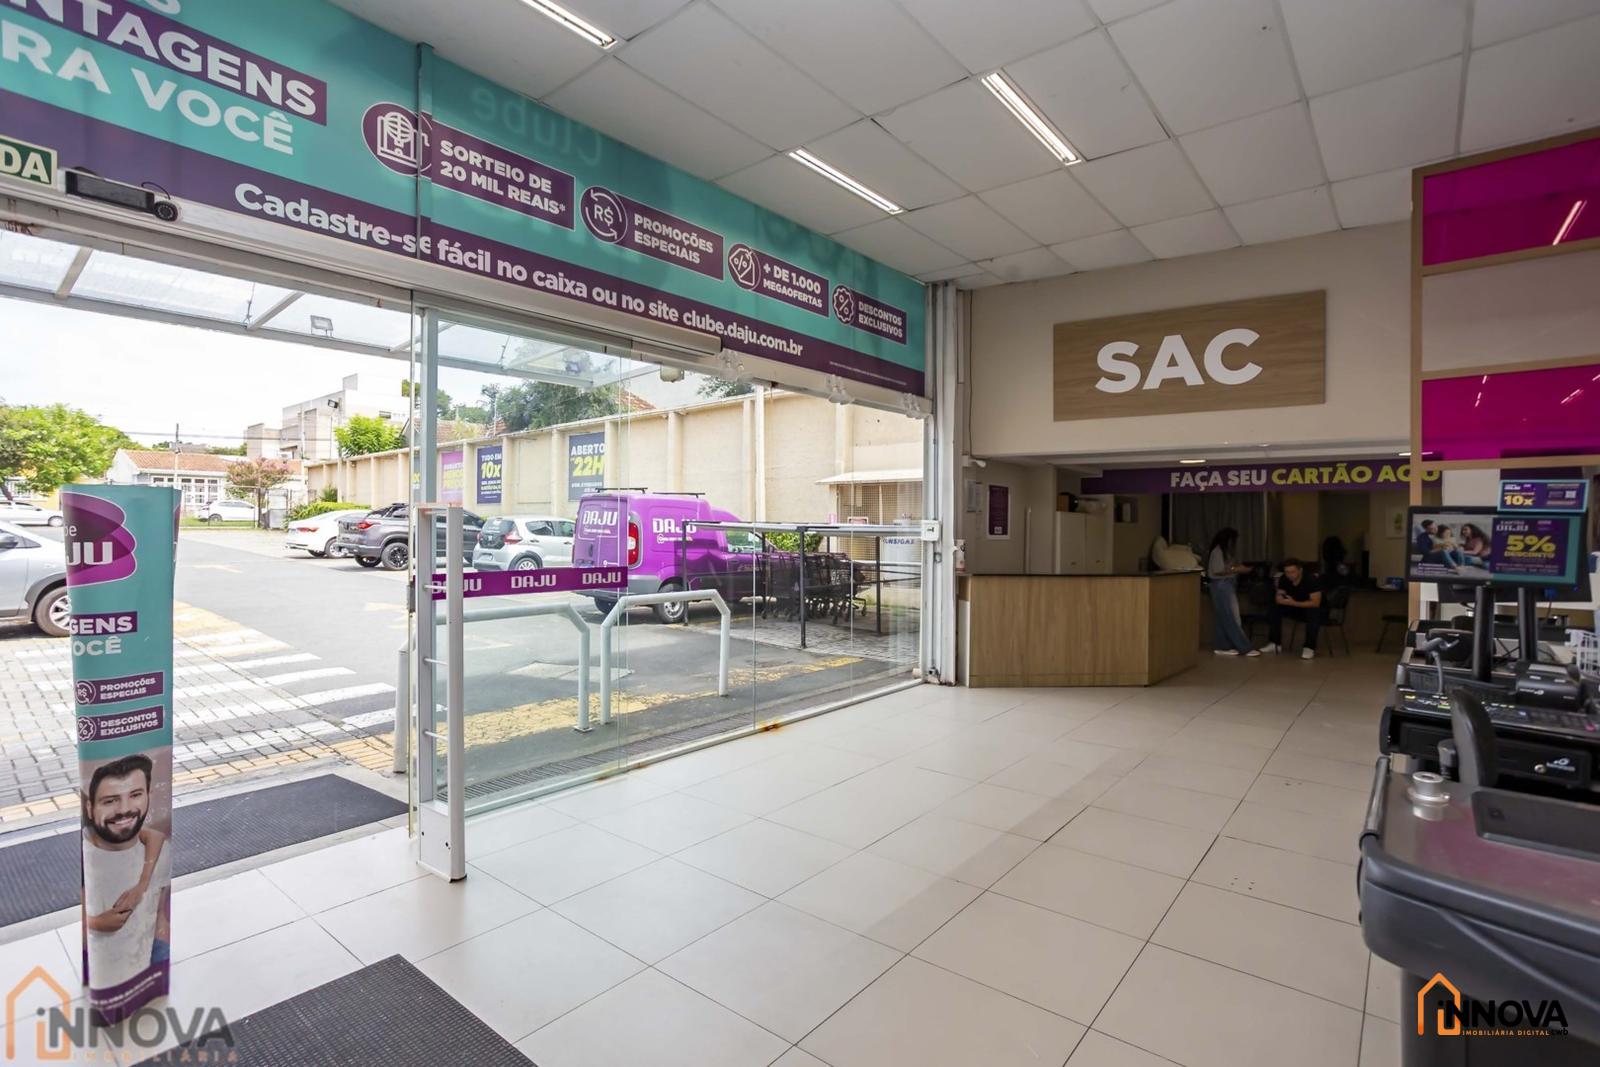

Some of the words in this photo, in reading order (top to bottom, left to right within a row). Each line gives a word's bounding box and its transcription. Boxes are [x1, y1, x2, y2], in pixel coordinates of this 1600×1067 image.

[1, 19, 111, 95] RA
[131, 67, 294, 155] VOCÊ
[0, 142, 50, 184] DA
[440, 140, 525, 183] SORTEIO
[529, 173, 552, 194] DE
[440, 161, 466, 181] 20
[471, 171, 504, 196] MIL
[634, 213, 713, 253] PROMOÇÕES
[634, 230, 700, 264] ESPECIAIS
[235, 182, 431, 254] Cadastre-se
[437, 238, 491, 274] fácil
[497, 260, 528, 282] no
[532, 270, 587, 298] caixa
[592, 285, 617, 307] ou
[621, 294, 644, 313] no
[649, 300, 679, 322] site
[683, 310, 803, 356] clube.daju.com.br
[773, 265, 790, 283] DE
[791, 272, 821, 294] 1.000
[763, 278, 823, 308] MEGAOFERTAS
[858, 301, 903, 326] DESCONTOS
[858, 313, 904, 338] EXCLUSIVOS
[1094, 328, 1263, 393] SAC
[571, 443, 605, 456] ABERTO
[573, 455, 605, 476] 22H
[1170, 470, 1223, 491] FAÇA
[1227, 469, 1267, 487] SEU
[1271, 463, 1373, 486] CARTÃO
[583, 511, 618, 526] DAJU
[1506, 535, 1556, 552] 5%
[511, 575, 556, 589] DAJU
[582, 572, 621, 585] DAJU
[100, 677, 156, 692] PROMOÇÕES
[100, 687, 147, 700] ESPECIAIS
[101, 712, 157, 728] DESCONTOS
[101, 719, 158, 736] EXCLUSIVOS
